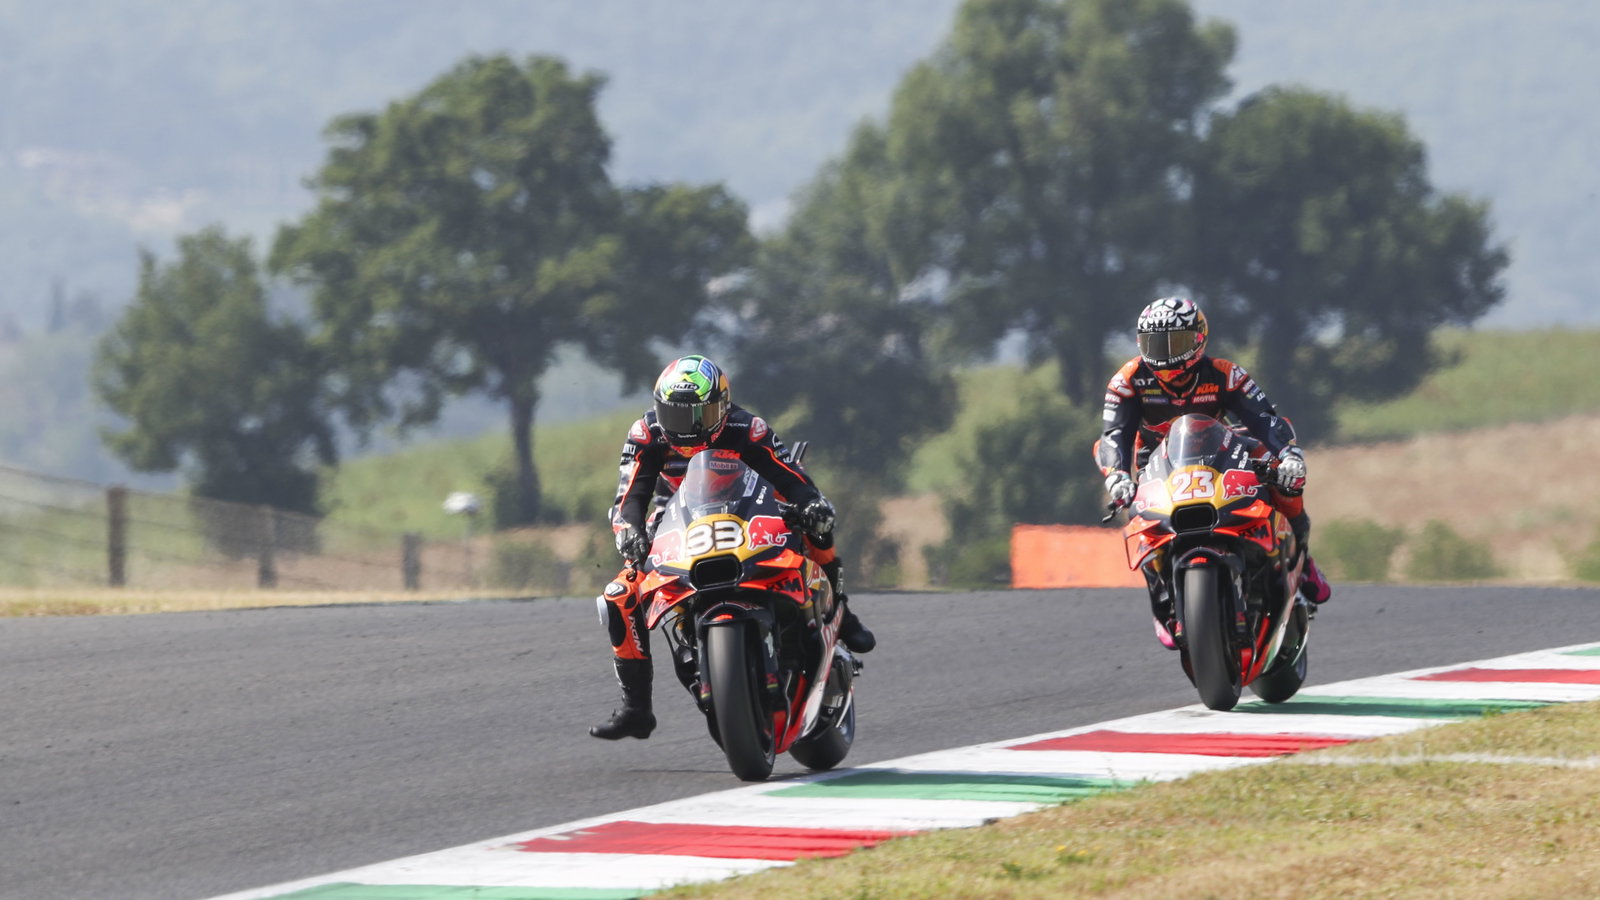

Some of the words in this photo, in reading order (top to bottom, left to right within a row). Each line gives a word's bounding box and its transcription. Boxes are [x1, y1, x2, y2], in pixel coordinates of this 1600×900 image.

[673, 382, 696, 390] HJC
[1196, 384, 1219, 394] KTM
[1193, 395, 1216, 403] MOTUL
[1172, 470, 1215, 501] 23
[687, 521, 744, 556] 33
[628, 615, 644, 652] IXON
